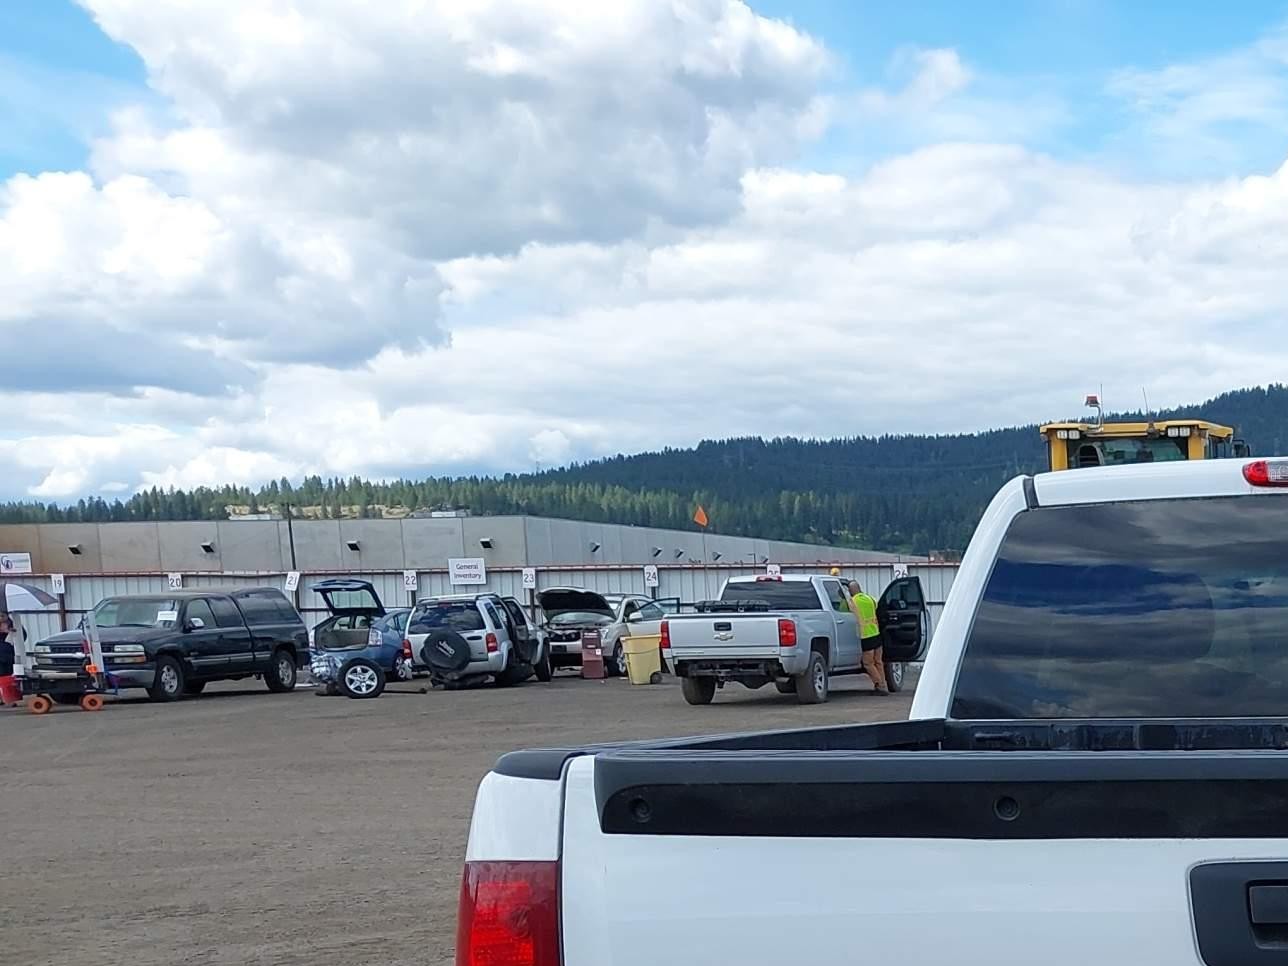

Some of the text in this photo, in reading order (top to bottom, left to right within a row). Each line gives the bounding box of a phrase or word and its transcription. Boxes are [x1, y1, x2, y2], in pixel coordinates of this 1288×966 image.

[287, 575, 297, 585] 21
[405, 575, 416, 585] 22
[523, 573, 534, 583] 23
[646, 572, 657, 581] 24
[54, 579, 62, 588] 19
[169, 577, 181, 588] 20
